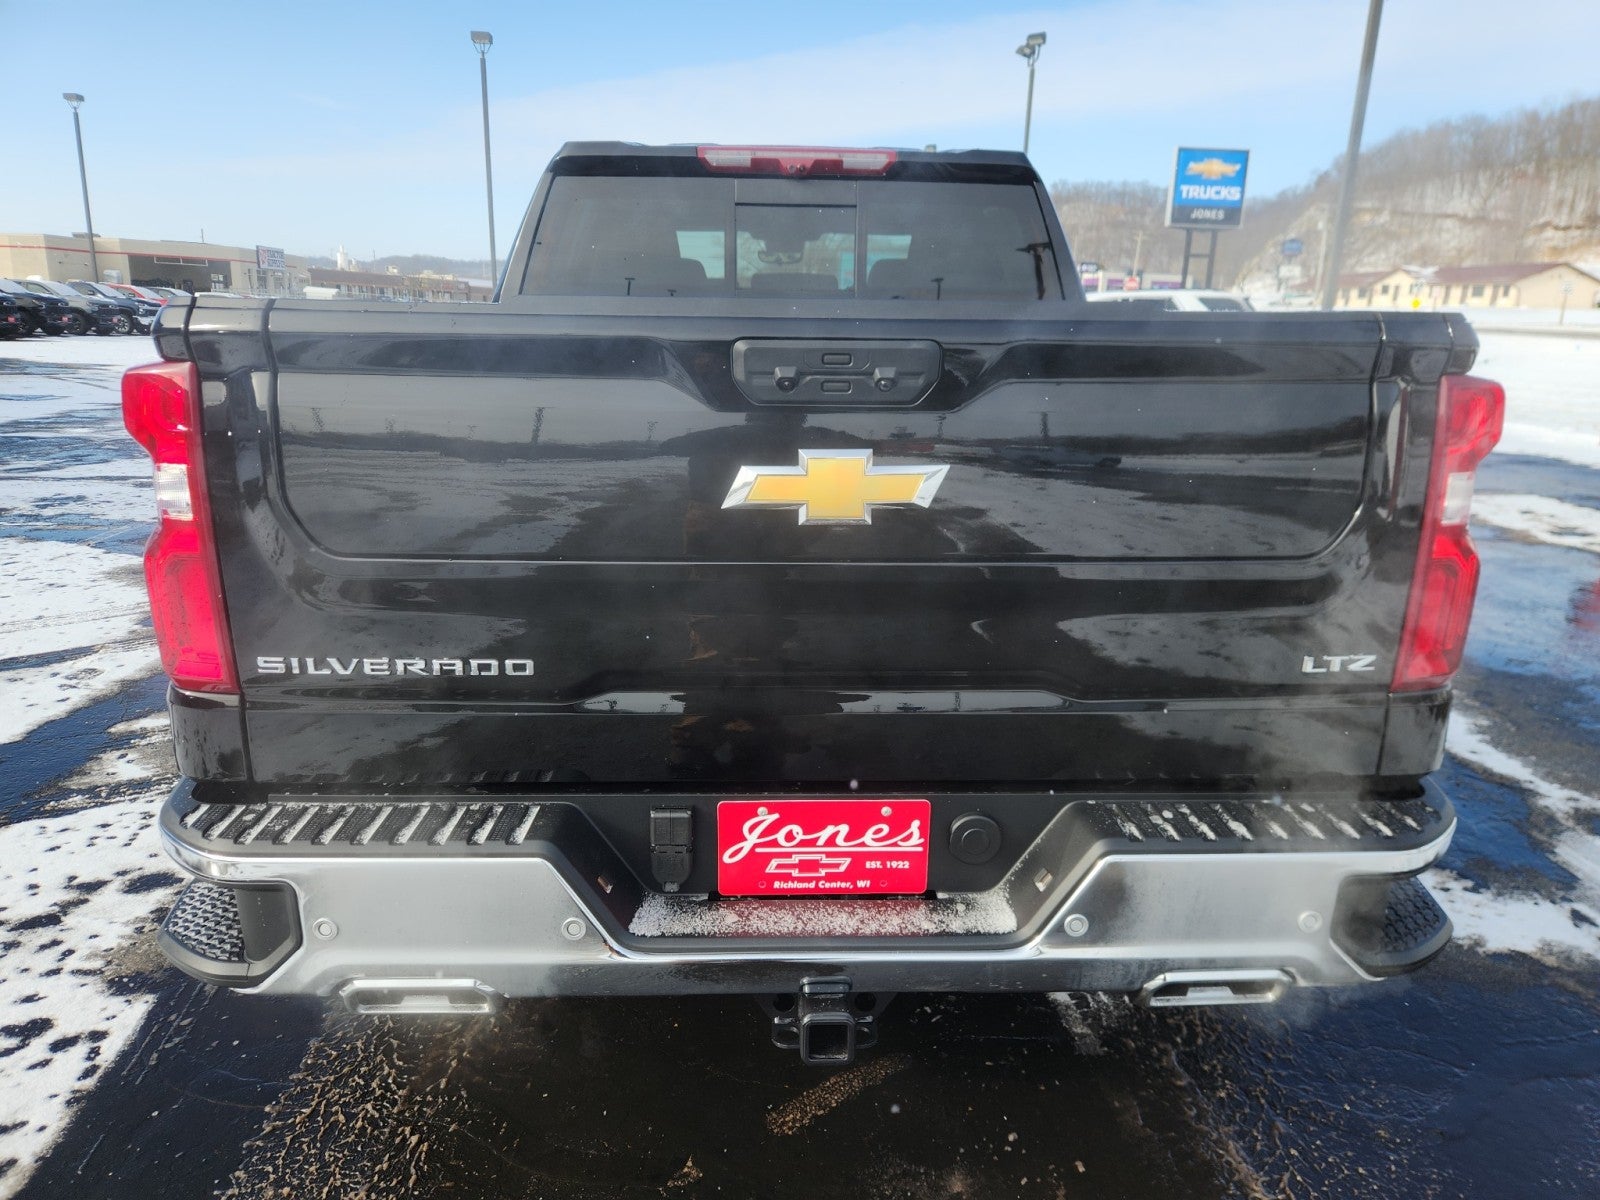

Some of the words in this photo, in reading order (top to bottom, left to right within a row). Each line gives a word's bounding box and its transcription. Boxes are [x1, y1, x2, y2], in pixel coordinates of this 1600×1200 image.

[1180, 184, 1242, 201] TRUCKS
[1190, 208, 1225, 221] JONES
[256, 656, 535, 676] SILVERADO
[1301, 654, 1377, 673] LTZ
[722, 813, 925, 864] Jones
[865, 861, 883, 869] EST.
[886, 861, 910, 869] 1922
[773, 880, 815, 889] Richland
[818, 880, 854, 889] Center,
[856, 880, 871, 888] WI
